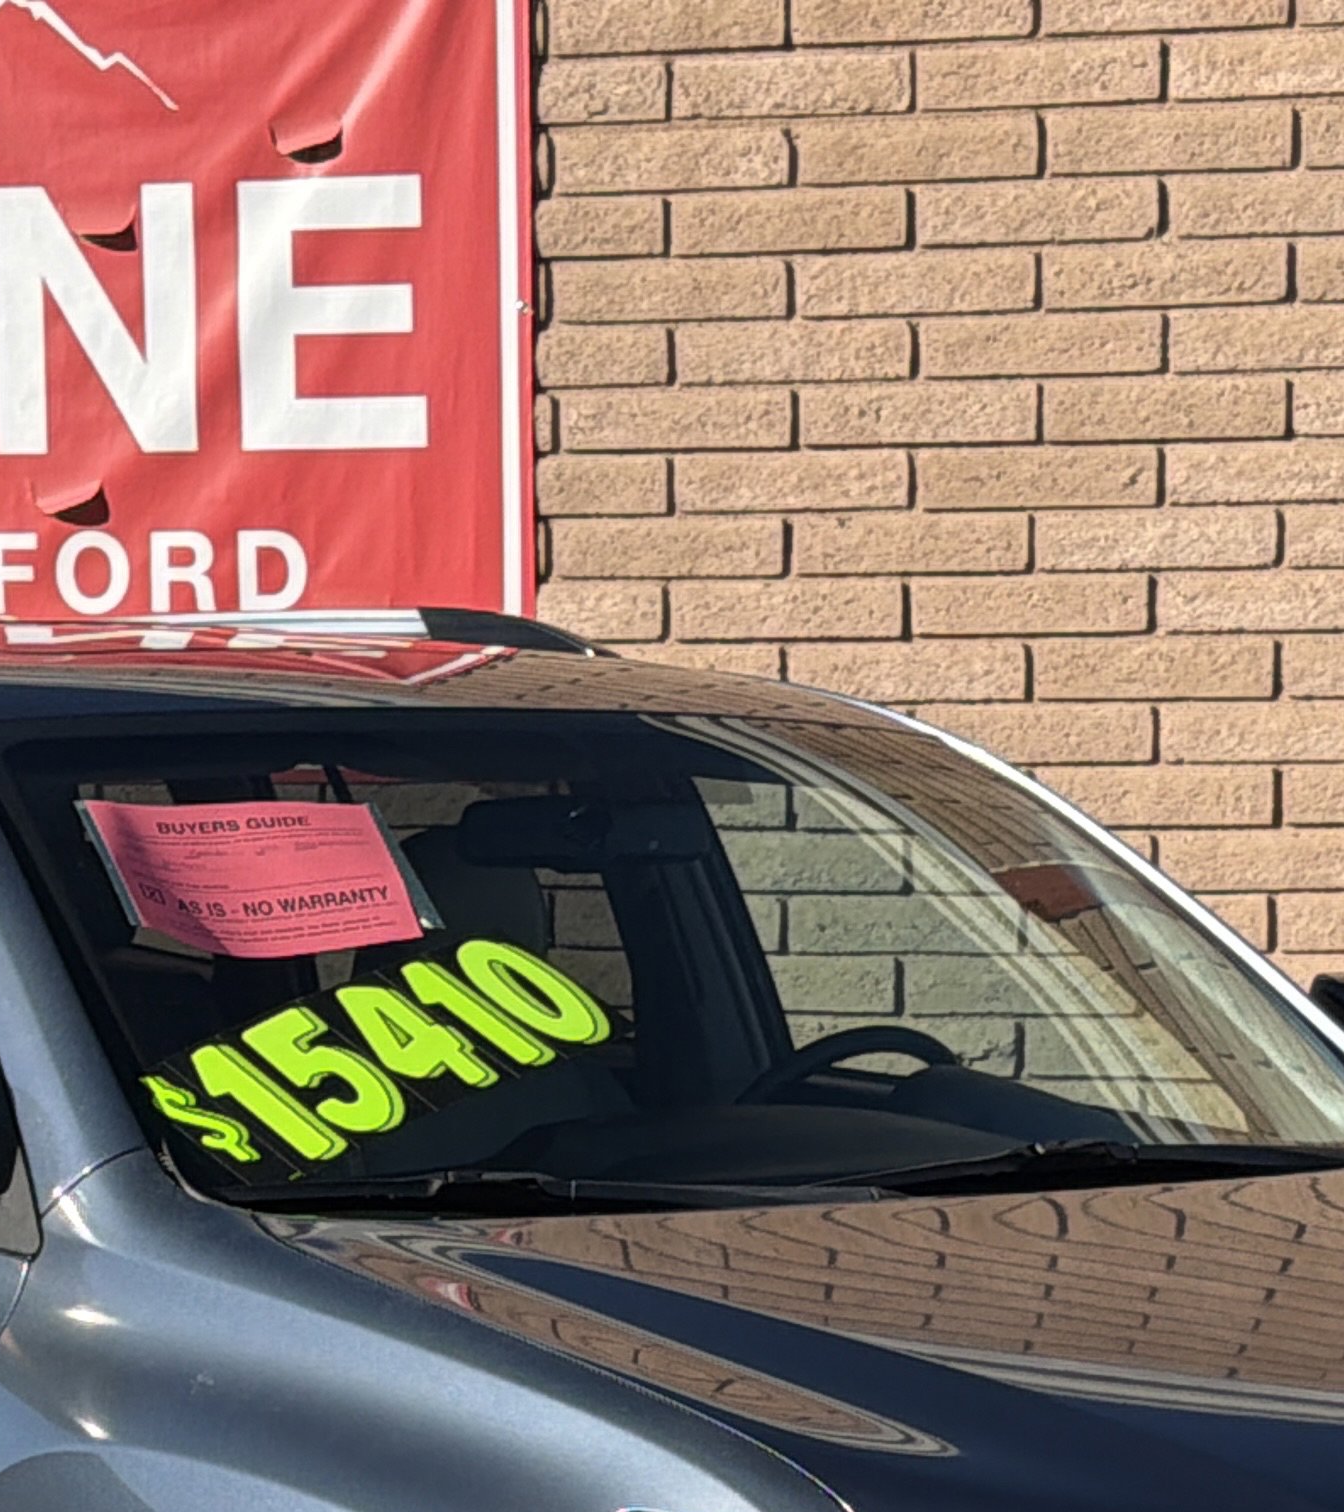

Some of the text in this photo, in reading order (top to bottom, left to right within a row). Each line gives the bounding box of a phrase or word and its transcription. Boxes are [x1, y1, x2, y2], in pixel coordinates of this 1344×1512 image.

[155, 814, 312, 836] BUYERS GUIDE
[176, 899, 202, 918] AS
[206, 900, 227, 919] IS
[242, 898, 274, 918] NO
[277, 885, 389, 915] WARRANTY
[138, 939, 611, 1163] $15410
